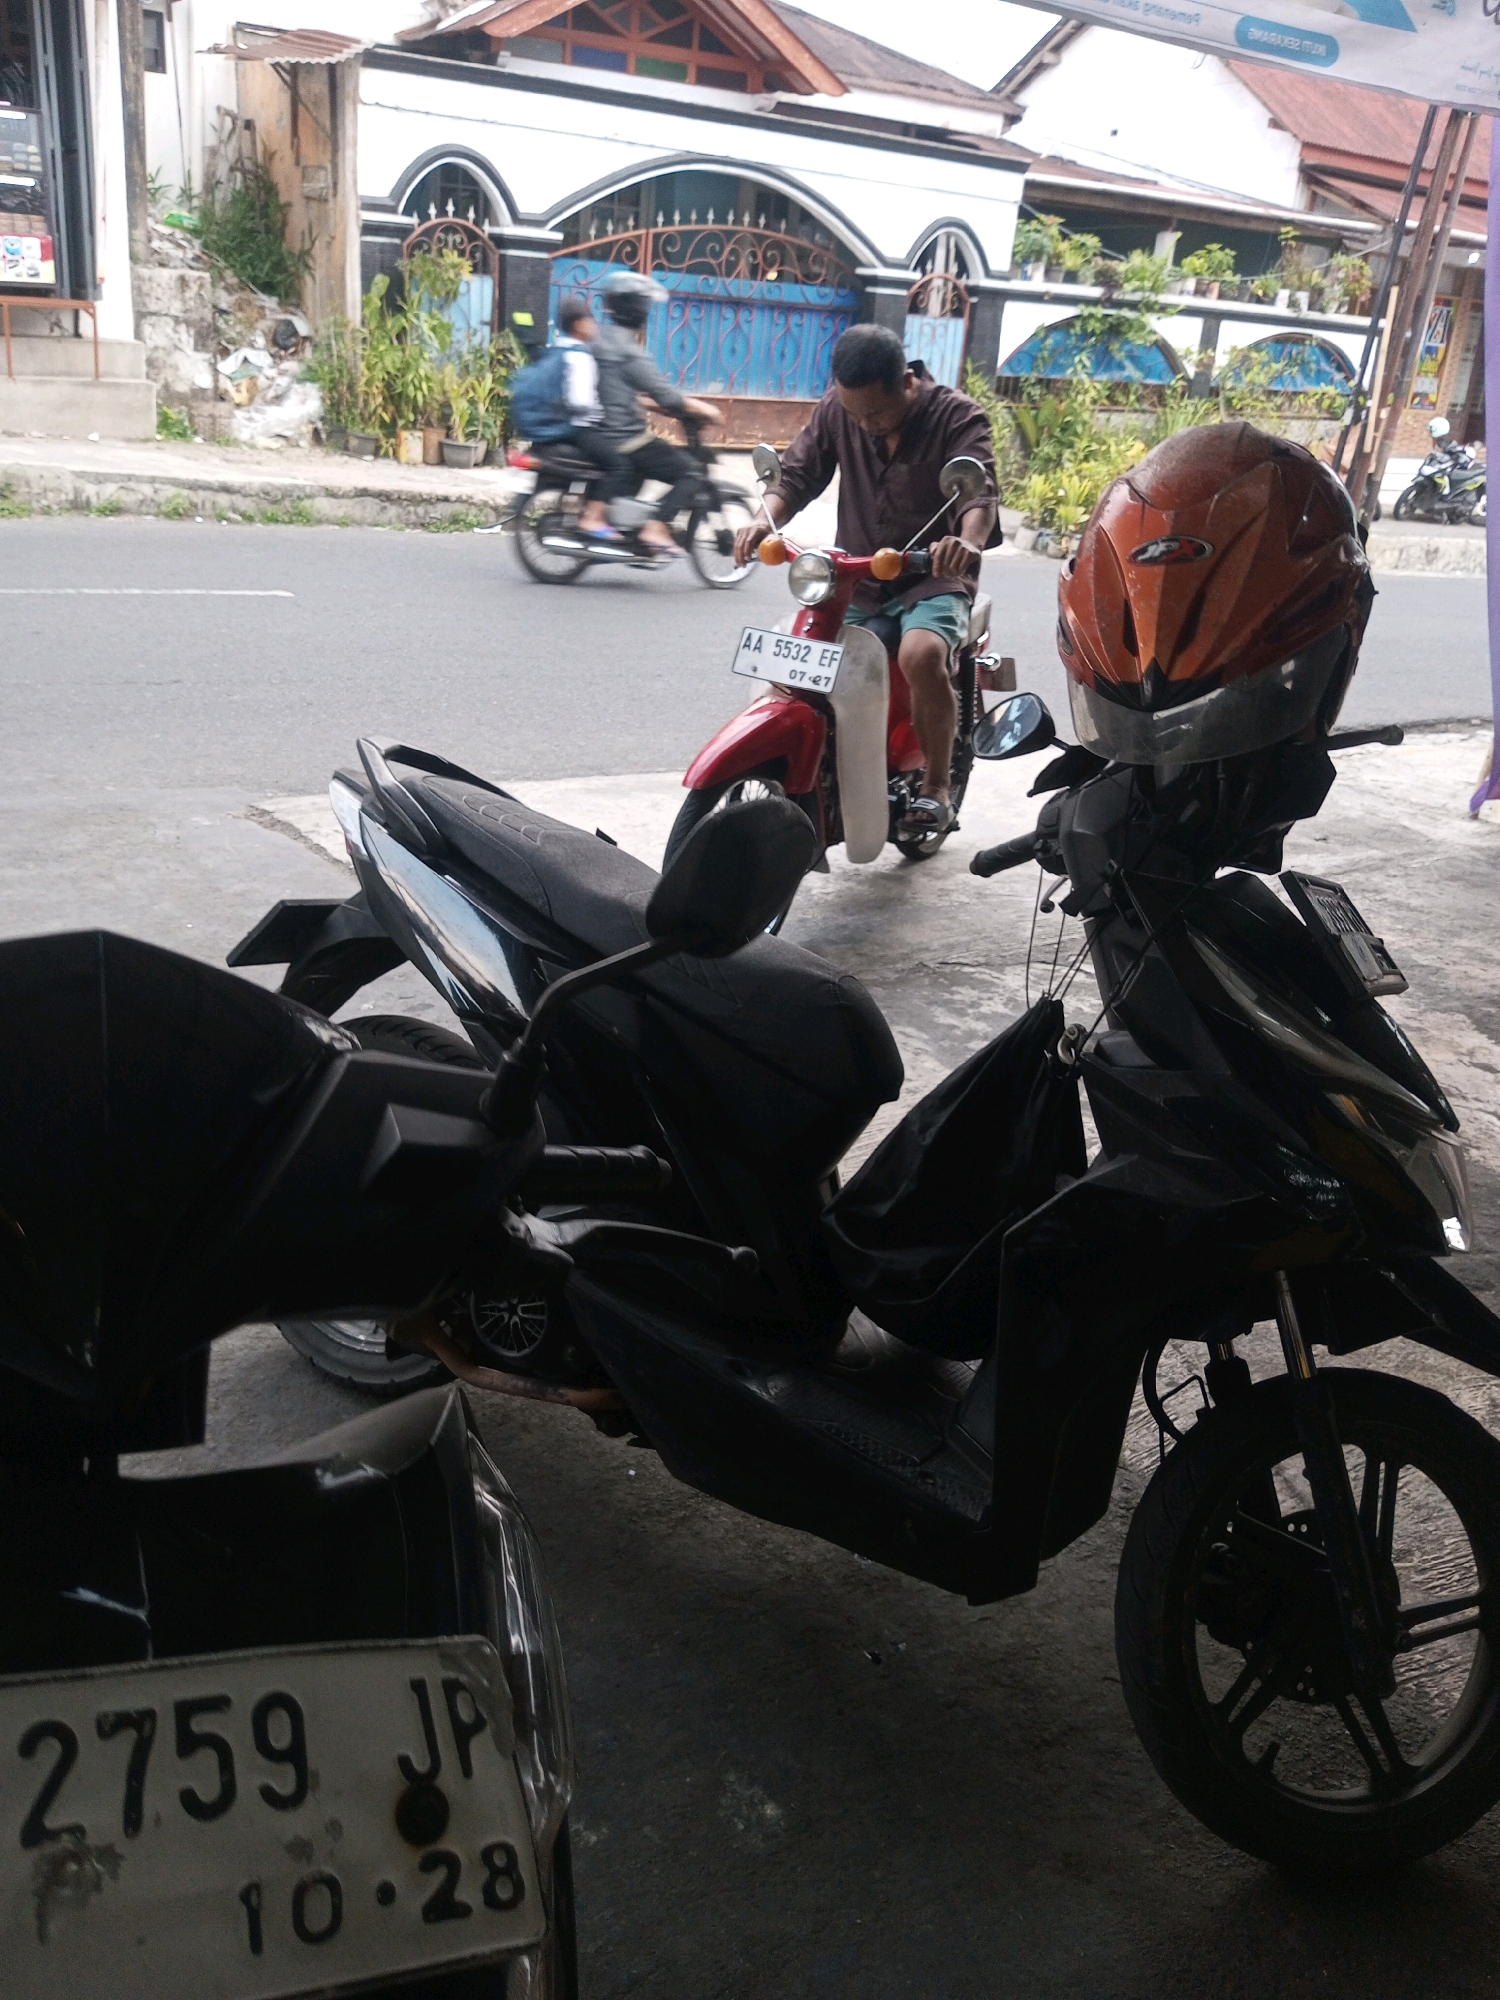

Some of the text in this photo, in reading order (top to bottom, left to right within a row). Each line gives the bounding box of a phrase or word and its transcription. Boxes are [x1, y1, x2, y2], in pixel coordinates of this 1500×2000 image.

[742, 632, 840, 668] AA 5532 EF
[18, 1676, 488, 1848] 2759 JP
